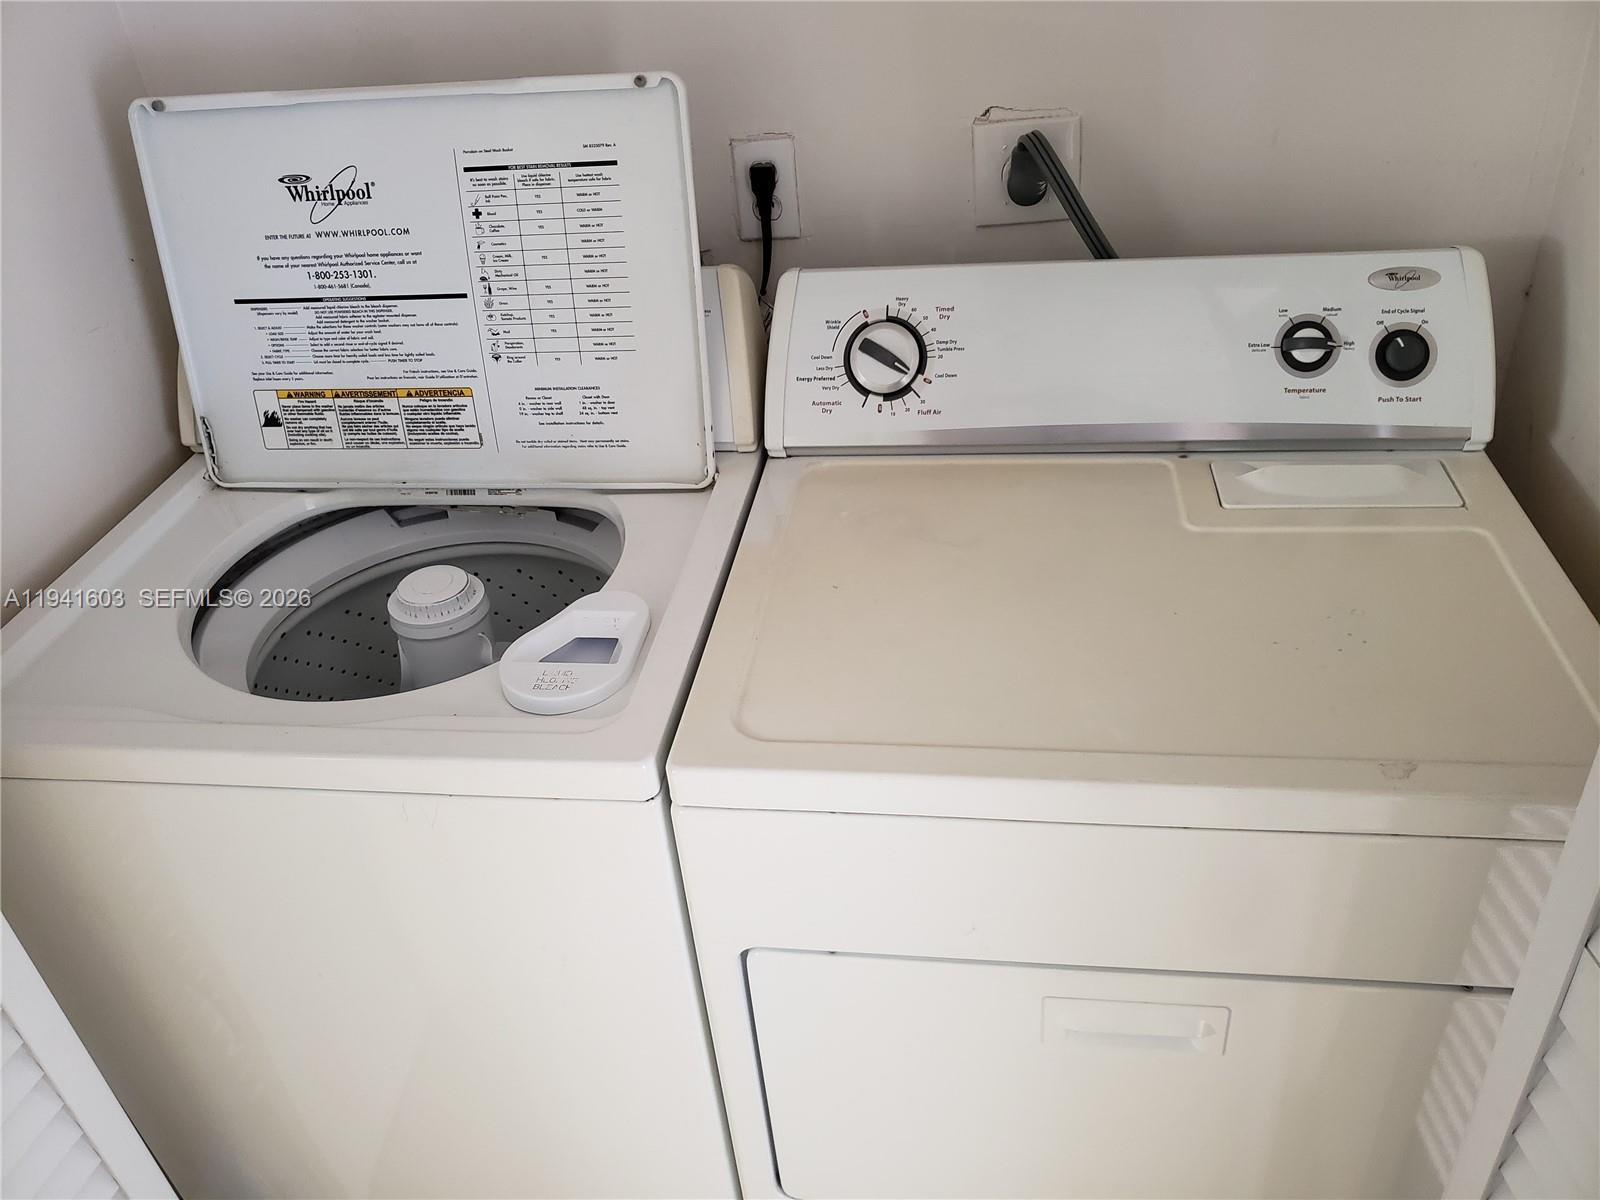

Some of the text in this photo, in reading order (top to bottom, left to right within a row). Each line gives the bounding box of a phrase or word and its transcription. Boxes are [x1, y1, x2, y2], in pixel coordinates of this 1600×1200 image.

[315, 228, 410, 238] WWW.WHIRLPOOL.COM
[307, 269, 377, 280] 1-800-253-1301.
[1387, 274, 1421, 282] Whirlpool
[1409, 307, 1426, 315] Signal
[293, 391, 326, 399] WARNING
[341, 390, 397, 399] AVERTISSEMENT
[414, 389, 465, 397] ADVERTENCIA
